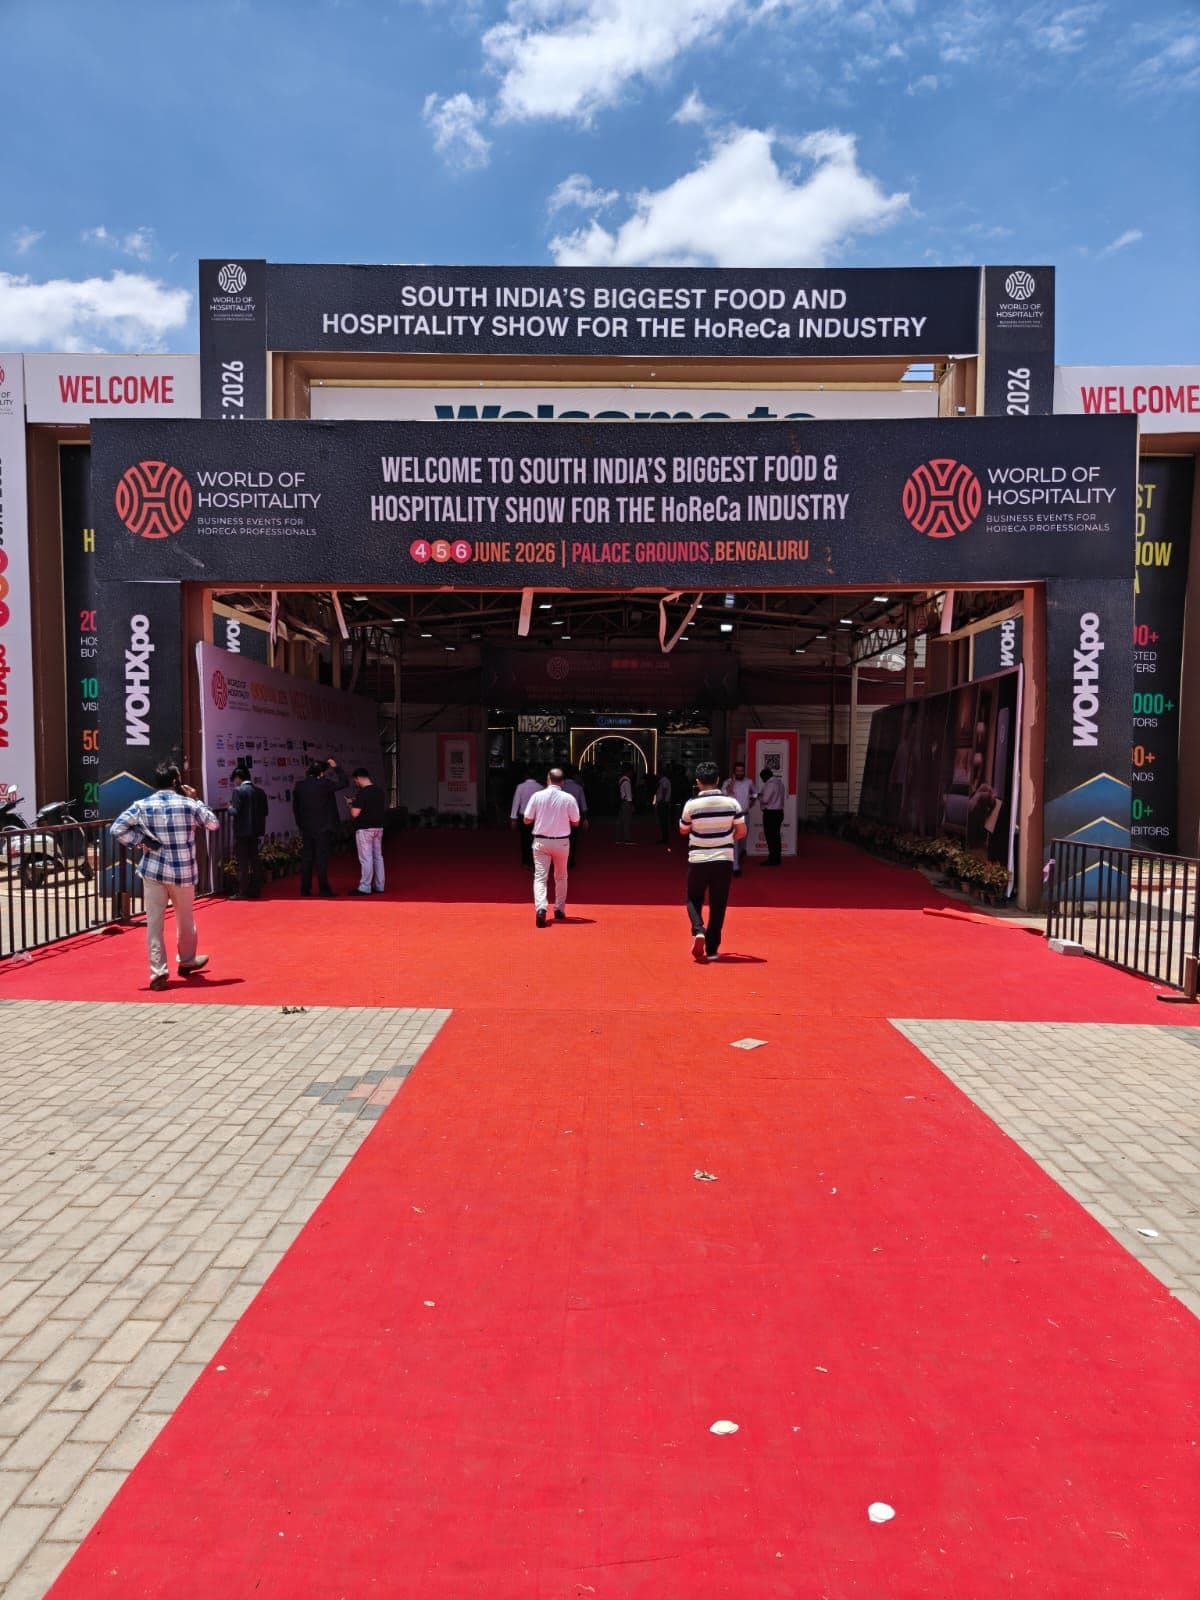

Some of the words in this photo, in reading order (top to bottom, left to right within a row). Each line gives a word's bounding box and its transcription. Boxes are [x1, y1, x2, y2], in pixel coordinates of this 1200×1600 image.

[401, 285, 488, 308] SOUTH
[496, 287, 586, 309] INDIA’S
[593, 287, 707, 310] BIGGEST
[714, 288, 786, 310] FOOD
[792, 289, 847, 310] AND
[322, 313, 485, 337] HOSPITALITY
[491, 316, 570, 337] SHOW
[577, 317, 628, 338] FOR
[636, 317, 686, 338] THE
[694, 317, 791, 339] HoReCa
[798, 316, 927, 338] INDUSTRY
[59, 375, 175, 404] WELCOME
[222, 360, 244, 408] 2026
[1007, 367, 1030, 416] 2026
[1081, 385, 1200, 414] WELCOME
[196, 471, 273, 487] WORLD
[278, 472, 306, 487] OF
[381, 456, 483, 484] WELCOME
[487, 457, 514, 484] TO
[519, 457, 587, 484] SOUTH
[593, 456, 667, 484] INDIA’S
[672, 455, 759, 484] BIGGEST
[764, 454, 817, 482] FOOD
[823, 454, 838, 481] &
[987, 467, 1067, 484] WORLD
[1071, 466, 1101, 482] OF
[198, 492, 321, 509] HOSPITALITY
[370, 494, 500, 523] HOSPITALITY
[505, 497, 565, 523] SHOW
[571, 497, 610, 524] FOR
[615, 497, 656, 523] THE
[661, 496, 741, 523] HoReCa
[747, 494, 850, 522] INDUSTRY
[987, 488, 1116, 505] HOSPITALITY
[986, 514, 1034, 523] BUSINESS
[1036, 513, 1074, 522] EVENTS
[1076, 513, 1096, 521] FOR
[986, 525, 1027, 533] HORECA
[1029, 523, 1110, 532] PROFESSIONALS
[240, 528, 317, 536] PROFESSIONALS
[415, 543, 427, 558] 4
[436, 543, 448, 558] 5
[455, 543, 467, 558] 6
[473, 542, 511, 562] JUNE
[515, 542, 556, 563] 2026
[572, 542, 631, 563] PALACE
[126, 614, 154, 746] WOHXpo
[1073, 612, 1105, 747] WOHXpo
[1131, 745, 1156, 767] 0+
